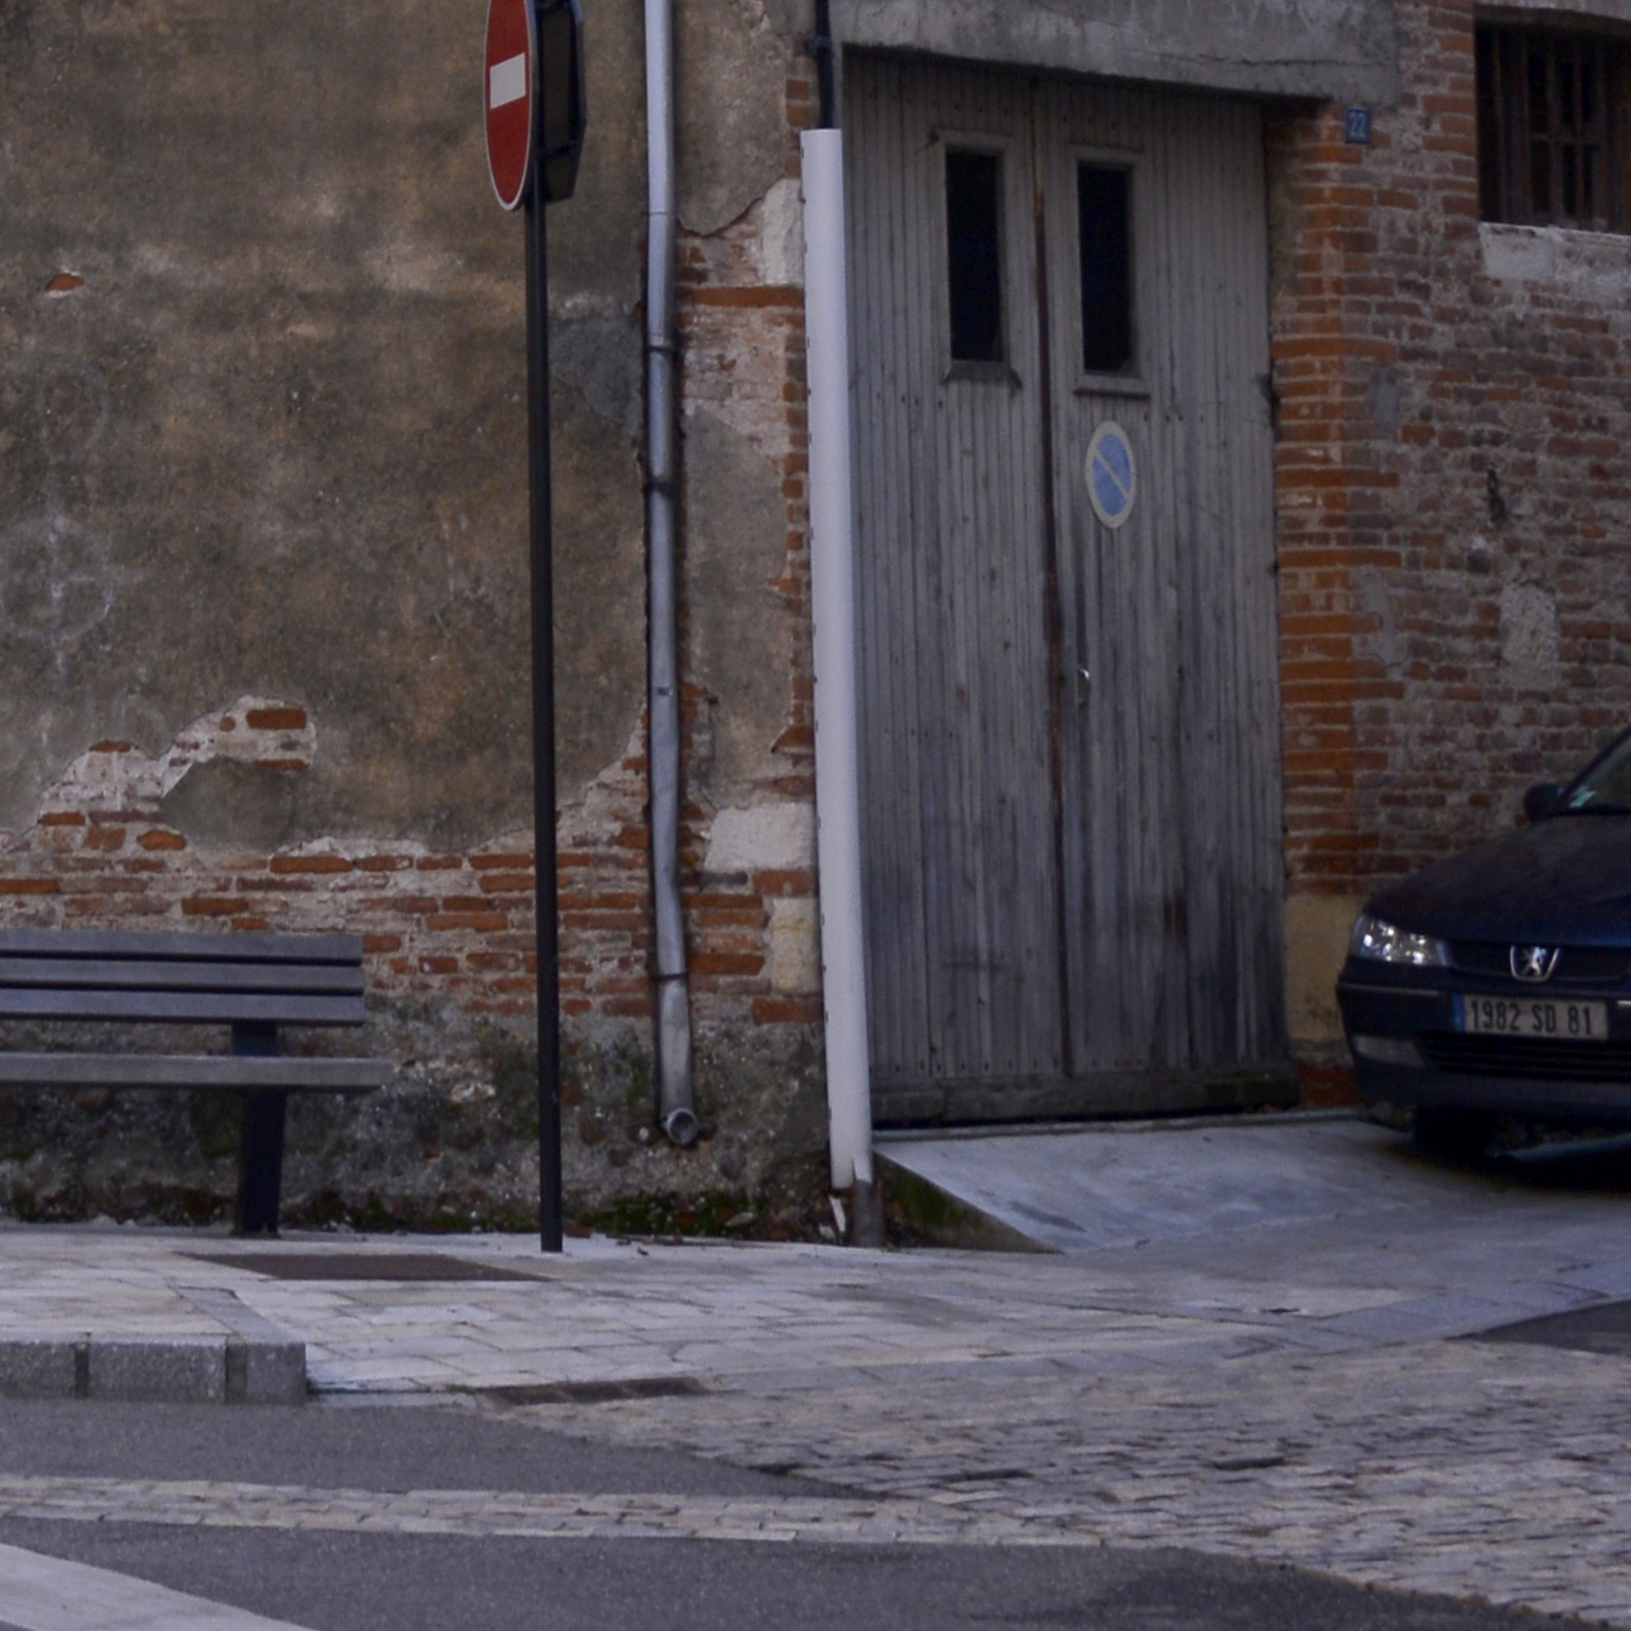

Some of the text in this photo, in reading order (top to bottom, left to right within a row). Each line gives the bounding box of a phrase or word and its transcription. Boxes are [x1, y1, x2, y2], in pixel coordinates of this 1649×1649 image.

[1348, 111, 1366, 139] 22
[1471, 1000, 1592, 1036] 1982 SD 81
